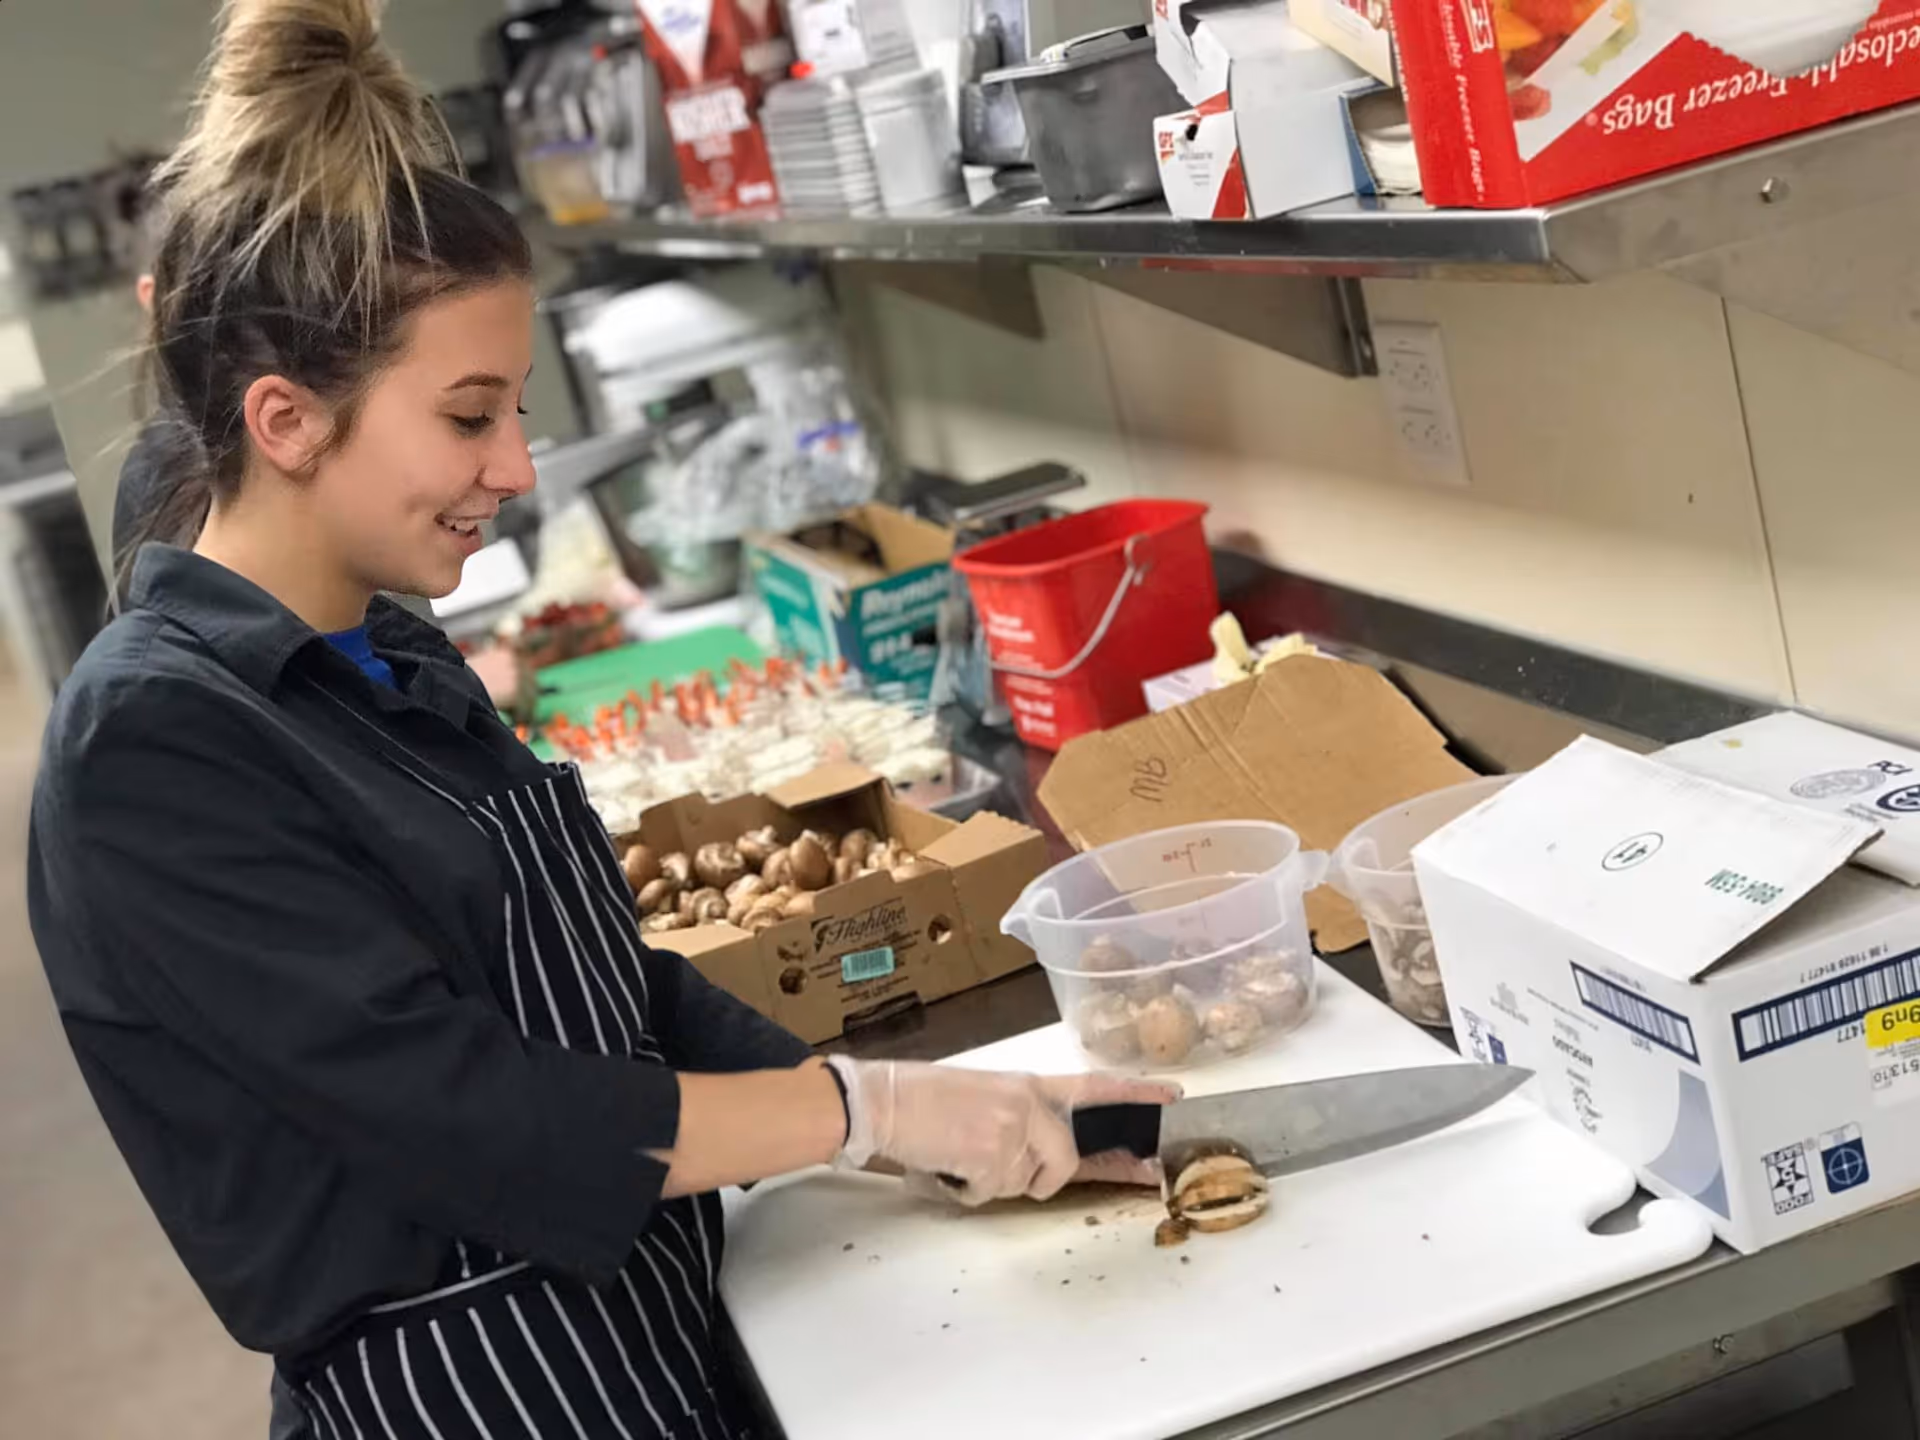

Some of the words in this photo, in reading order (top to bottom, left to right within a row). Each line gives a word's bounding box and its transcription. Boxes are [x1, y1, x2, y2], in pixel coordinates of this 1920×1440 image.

[1684, 69, 1788, 112] Freezer
[1602, 91, 1676, 135] Bags
[1455, 74, 1476, 144] Freezer
[1468, 147, 1486, 192] Bags
[1765, 1143, 1802, 1166] SAFE
[1781, 1166, 1796, 1186] 5
[1774, 1193, 1812, 1214] FOOD
